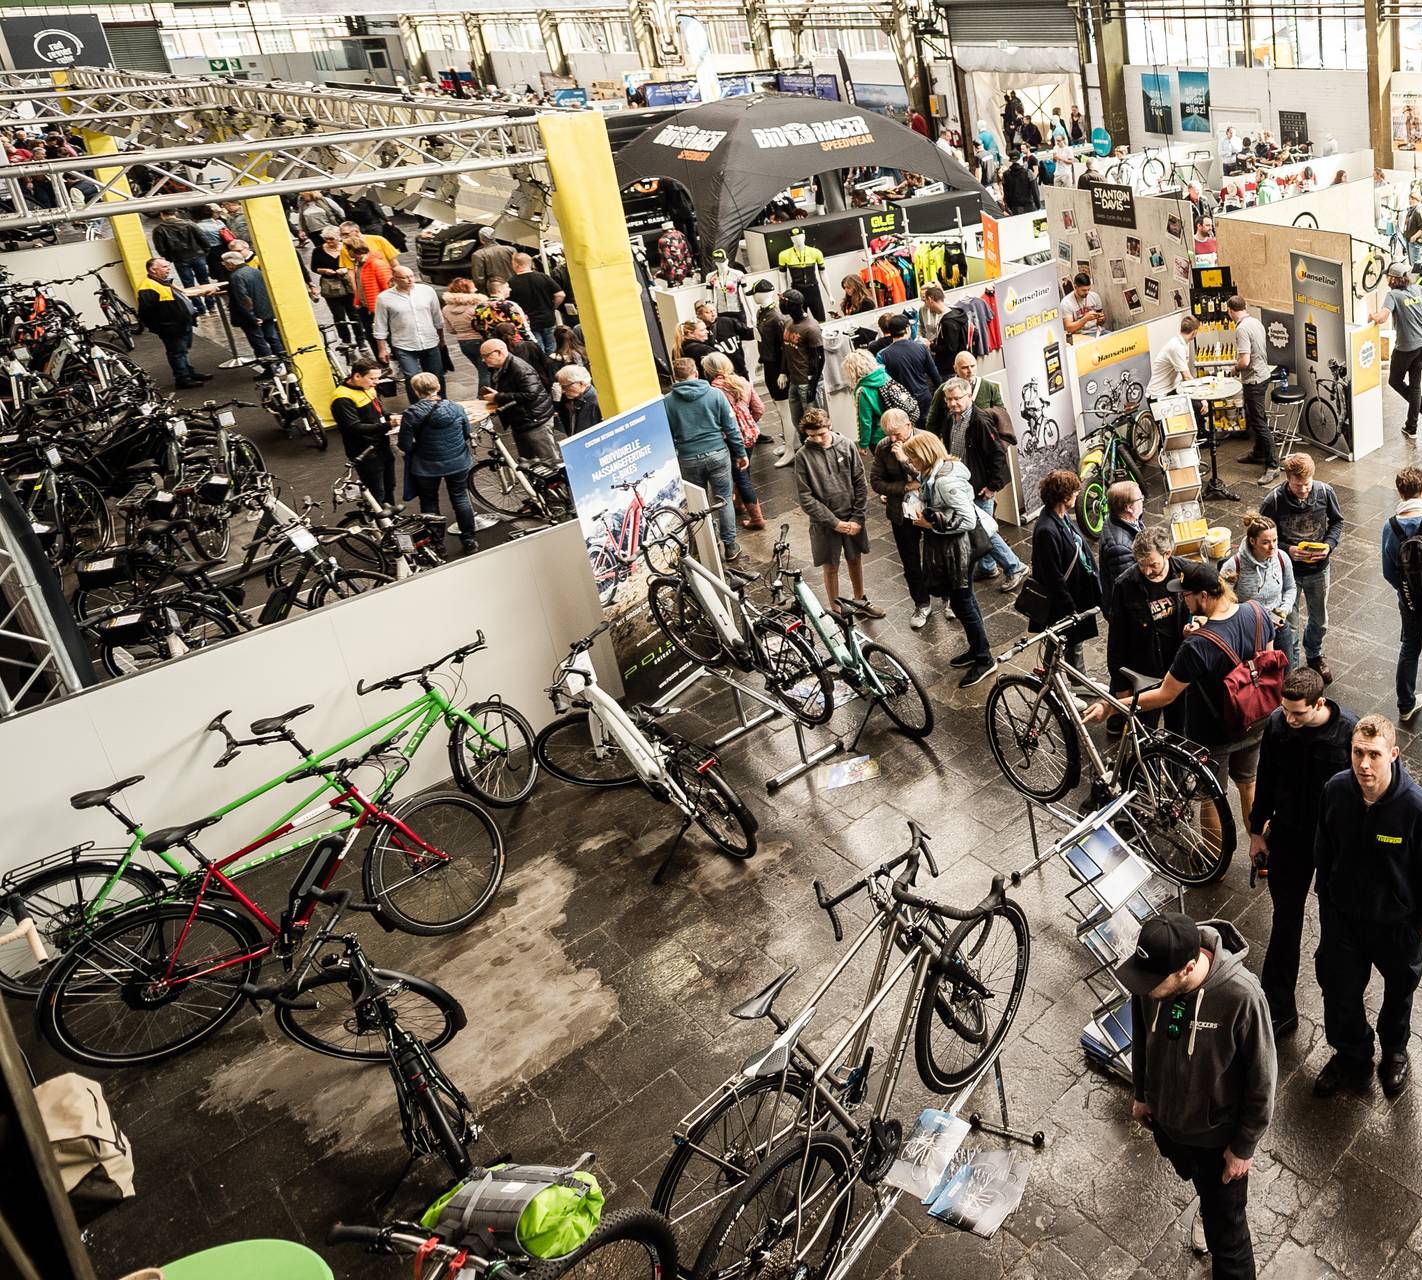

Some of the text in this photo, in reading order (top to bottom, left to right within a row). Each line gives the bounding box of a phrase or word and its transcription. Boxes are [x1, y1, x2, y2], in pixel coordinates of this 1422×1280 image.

[1185, 96, 1206, 104] allez!
[1186, 105, 1207, 115] allez!
[810, 115, 870, 142] RACER
[820, 133, 875, 152] SPEEDWEAR
[1093, 187, 1131, 202] STANTON
[1101, 200, 1124, 211] DAVIS
[1301, 271, 1336, 286] Hanseline
[1012, 287, 1050, 307] Hanseline
[1097, 344, 1137, 362] Hanseline
[231, 829, 332, 875] POISON
